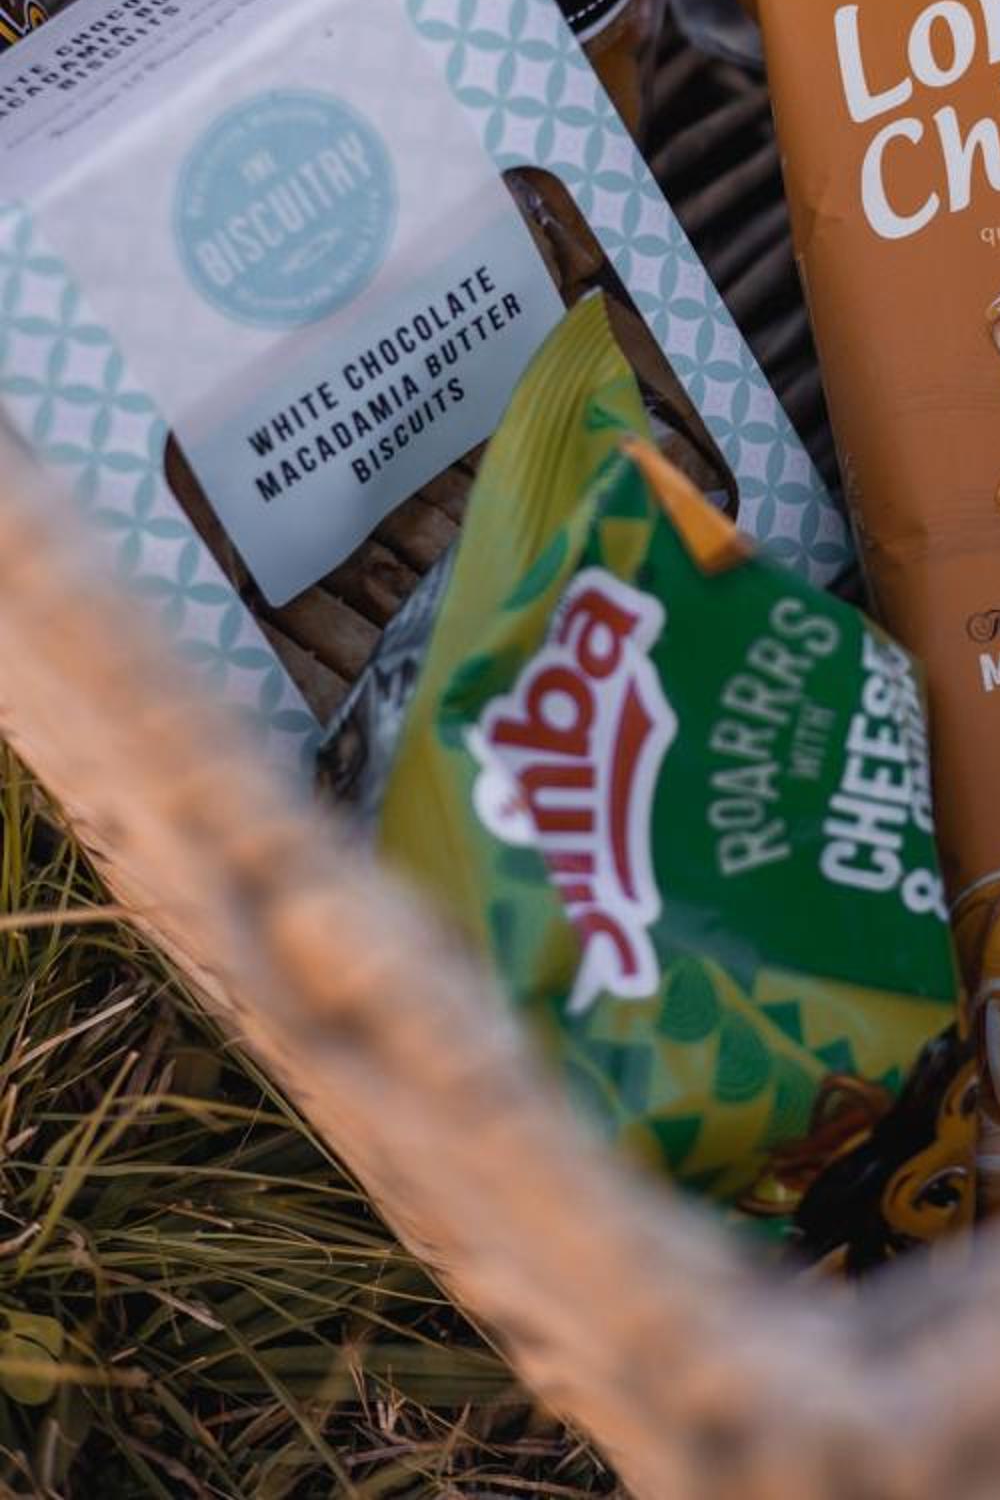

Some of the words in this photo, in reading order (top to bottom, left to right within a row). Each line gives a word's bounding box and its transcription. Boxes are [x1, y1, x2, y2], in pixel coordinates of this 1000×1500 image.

[196, 131, 372, 287] BISCUITRY
[247, 381, 338, 458] WHITE
[342, 265, 497, 391] CHOCOLATE
[254, 374, 420, 503] MACADAMIA
[425, 292, 523, 379] BUTTER
[351, 377, 466, 485] BISCUITS
[707, 597, 842, 878] ROARRS
[789, 703, 838, 782] WITH
